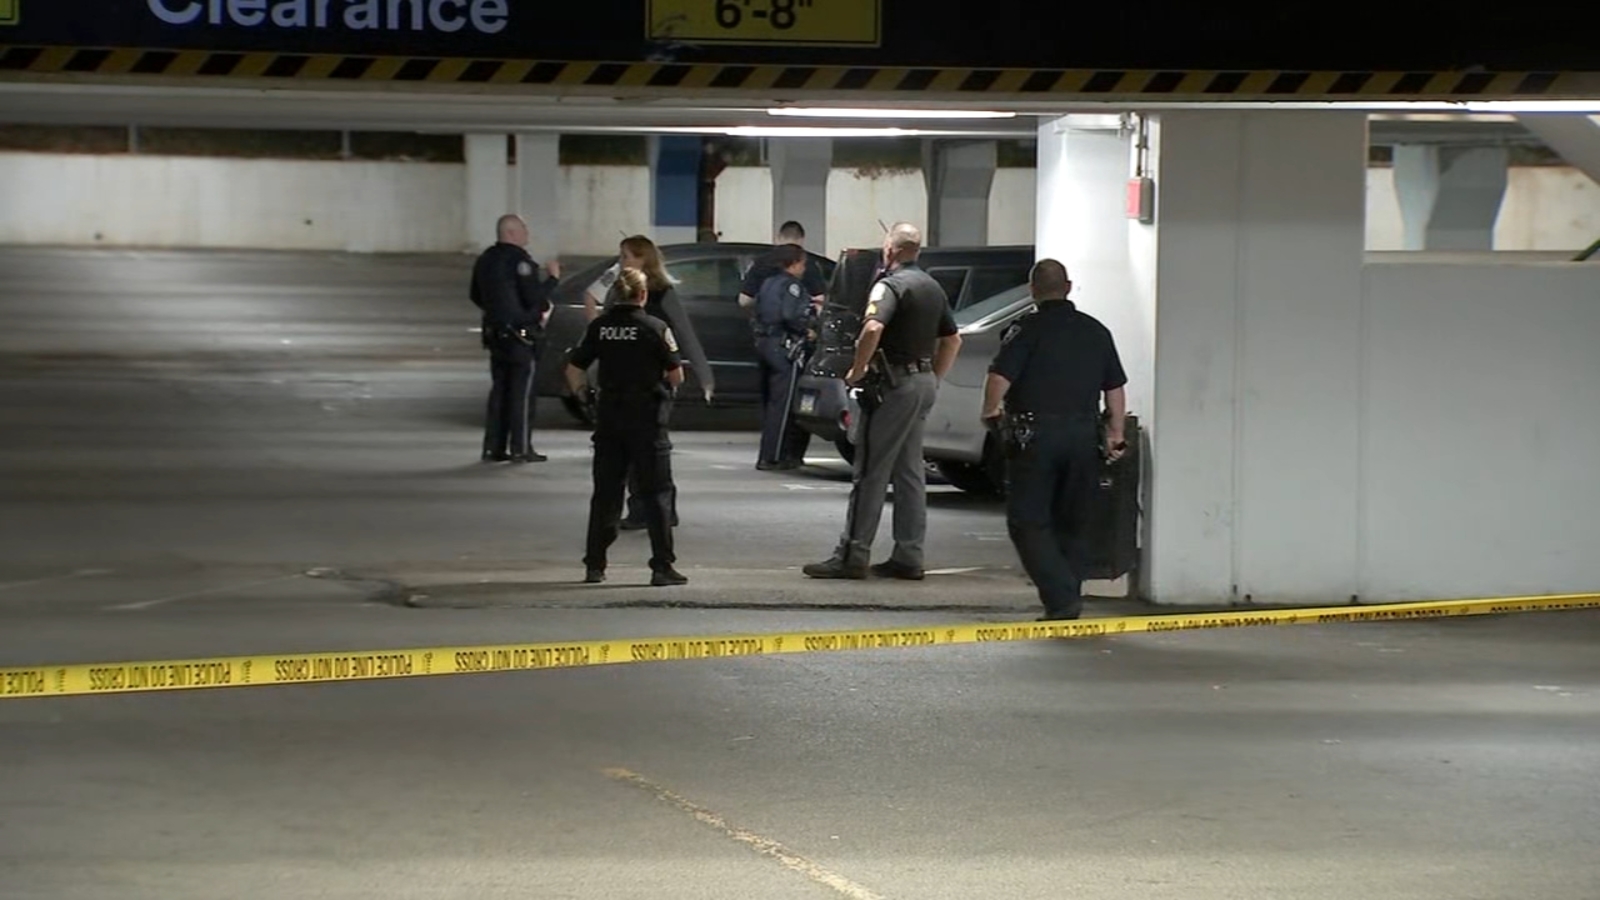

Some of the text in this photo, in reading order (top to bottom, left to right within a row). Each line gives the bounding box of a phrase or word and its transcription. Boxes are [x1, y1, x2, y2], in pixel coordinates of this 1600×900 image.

[599, 326, 638, 340] POLICE
[530, 648, 552, 667] LINE
[554, 646, 589, 666] POLICE
[630, 643, 665, 662] CROSS
[665, 642, 686, 660] NOT
[688, 641, 702, 659] DO
[704, 641, 727, 659] LINE
[729, 638, 763, 656] POLICE
[312, 658, 332, 679] NOT
[334, 657, 349, 678] DO
[351, 656, 374, 677] LINE
[375, 654, 411, 675] POLICE
[455, 651, 490, 672] CROSS
[491, 650, 511, 670] NOT
[514, 649, 527, 668] DO
[89, 667, 124, 690] CROSS
[128, 667, 149, 688] NOT
[151, 666, 166, 687] DO
[168, 665, 191, 686] LINE
[194, 662, 231, 685] POLICE
[275, 659, 309, 681] CROSS
[6, 670, 44, 694] POLICE
